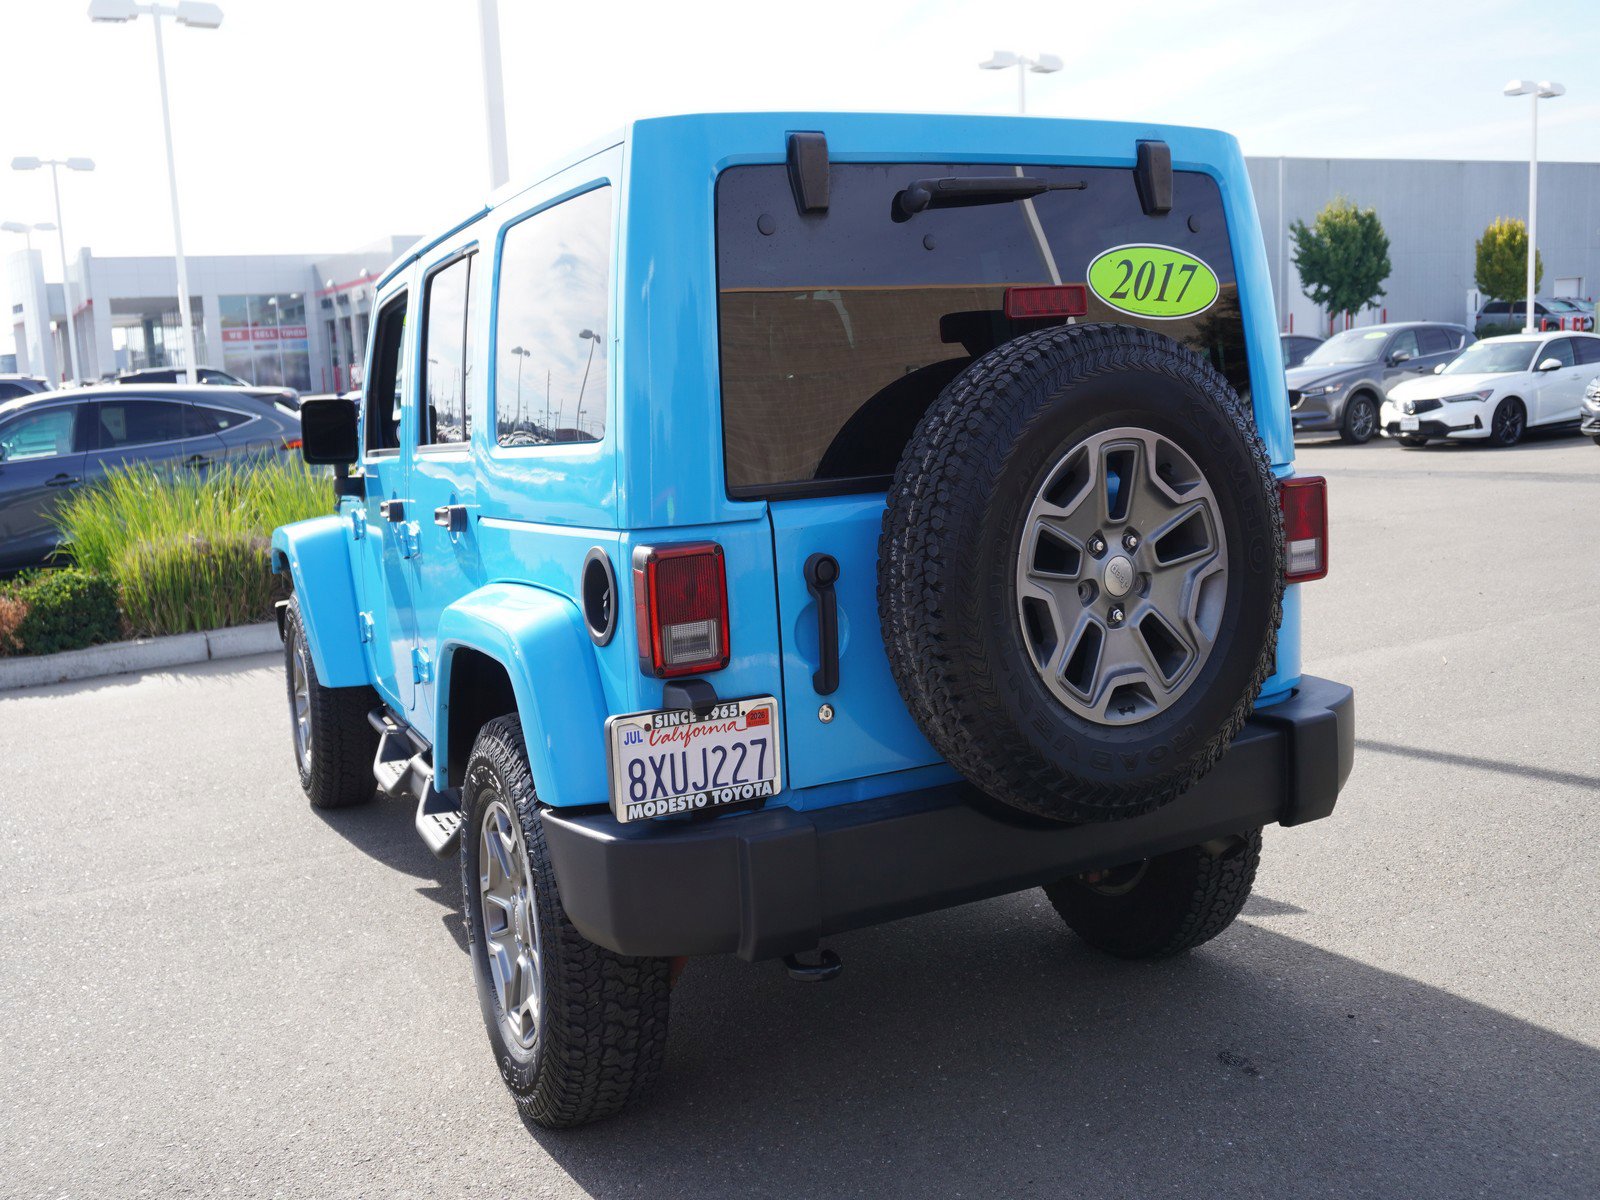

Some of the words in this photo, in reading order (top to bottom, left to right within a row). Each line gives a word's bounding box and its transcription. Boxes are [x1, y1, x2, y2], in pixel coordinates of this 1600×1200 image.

[1109, 258, 1198, 303] 2017
[654, 710, 697, 729] SINCE
[704, 704, 738, 721] 965
[624, 730, 643, 746] JUL
[649, 720, 748, 748] California
[628, 738, 767, 803] 8XUJ227
[628, 793, 708, 821] MODESTO
[711, 781, 774, 805] TOYOTA
